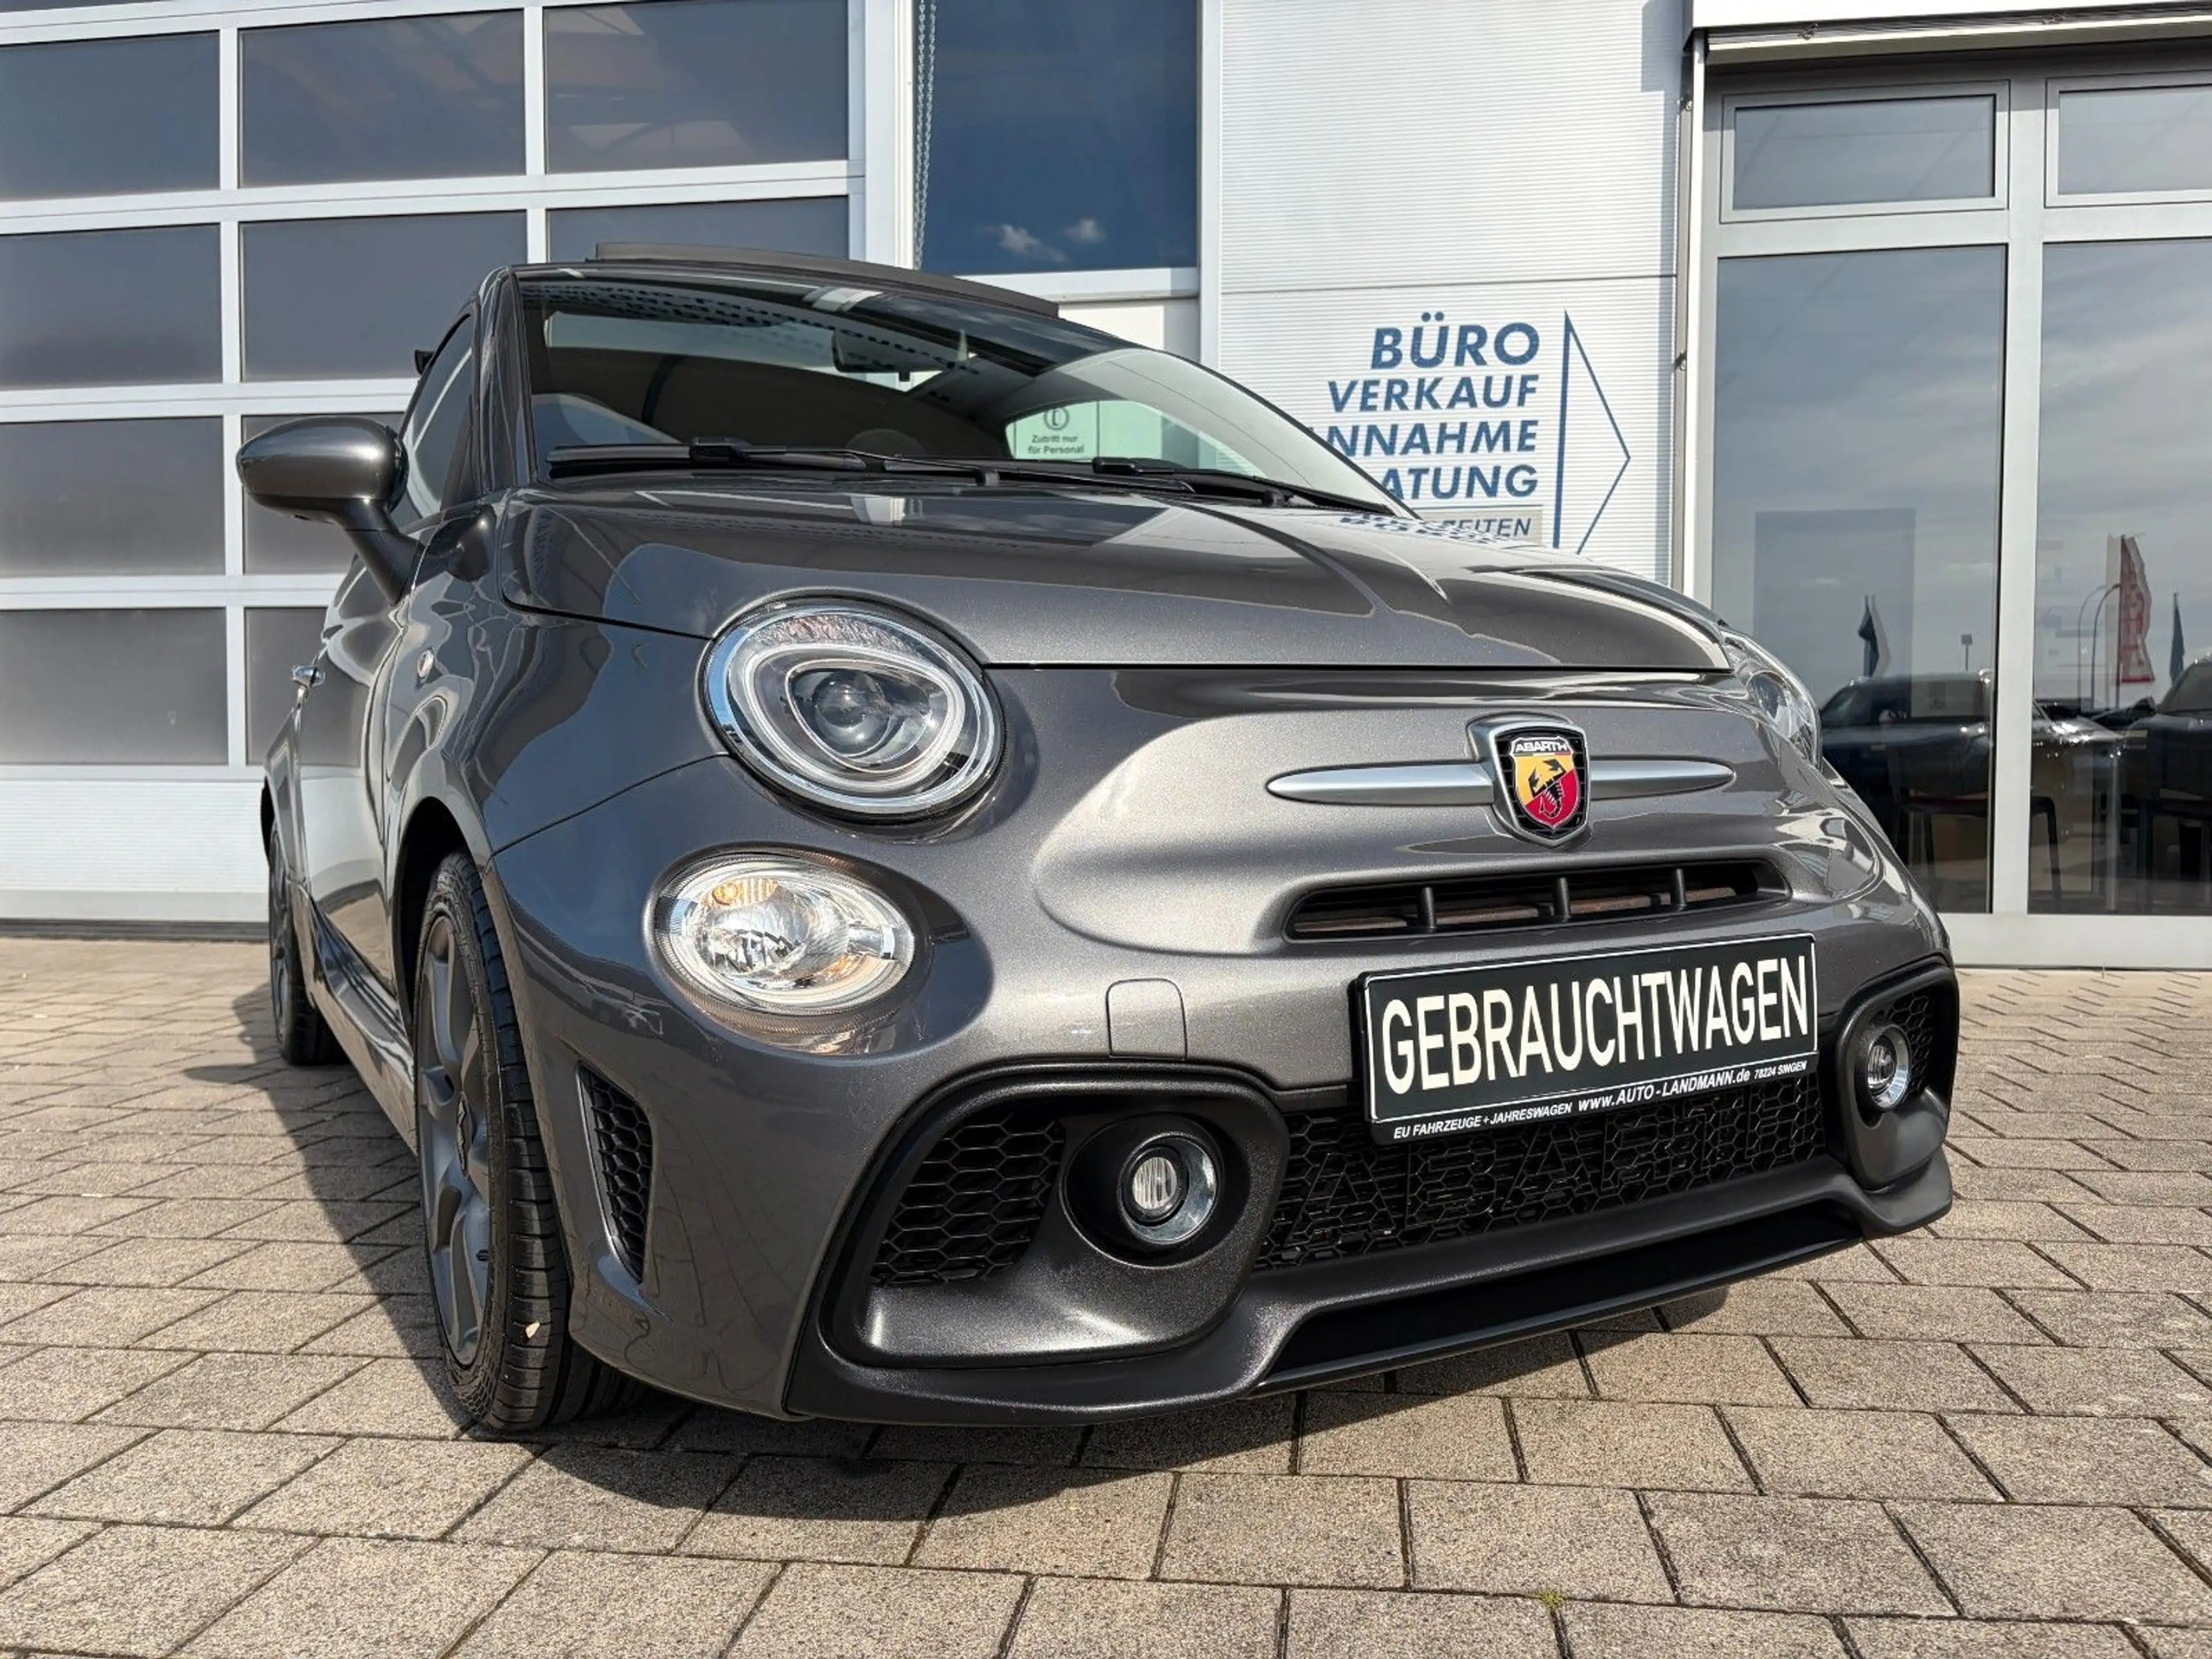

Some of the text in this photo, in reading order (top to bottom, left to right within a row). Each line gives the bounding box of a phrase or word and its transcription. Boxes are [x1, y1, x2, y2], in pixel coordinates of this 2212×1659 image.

[1371, 312, 1539, 369] BÜRO
[1328, 374, 1539, 412] VERKAUF
[1310, 419, 1538, 457] NNAHME
[1382, 464, 1538, 499] ATUNG
[1515, 741, 1567, 752] ABARTH
[1382, 956, 1808, 1094] GEBRAUCHTWAGEN
[1393, 1126, 1411, 1139] EU
[1754, 1066, 1777, 1080] 78224
[1777, 1060, 1808, 1075] SINGEN
